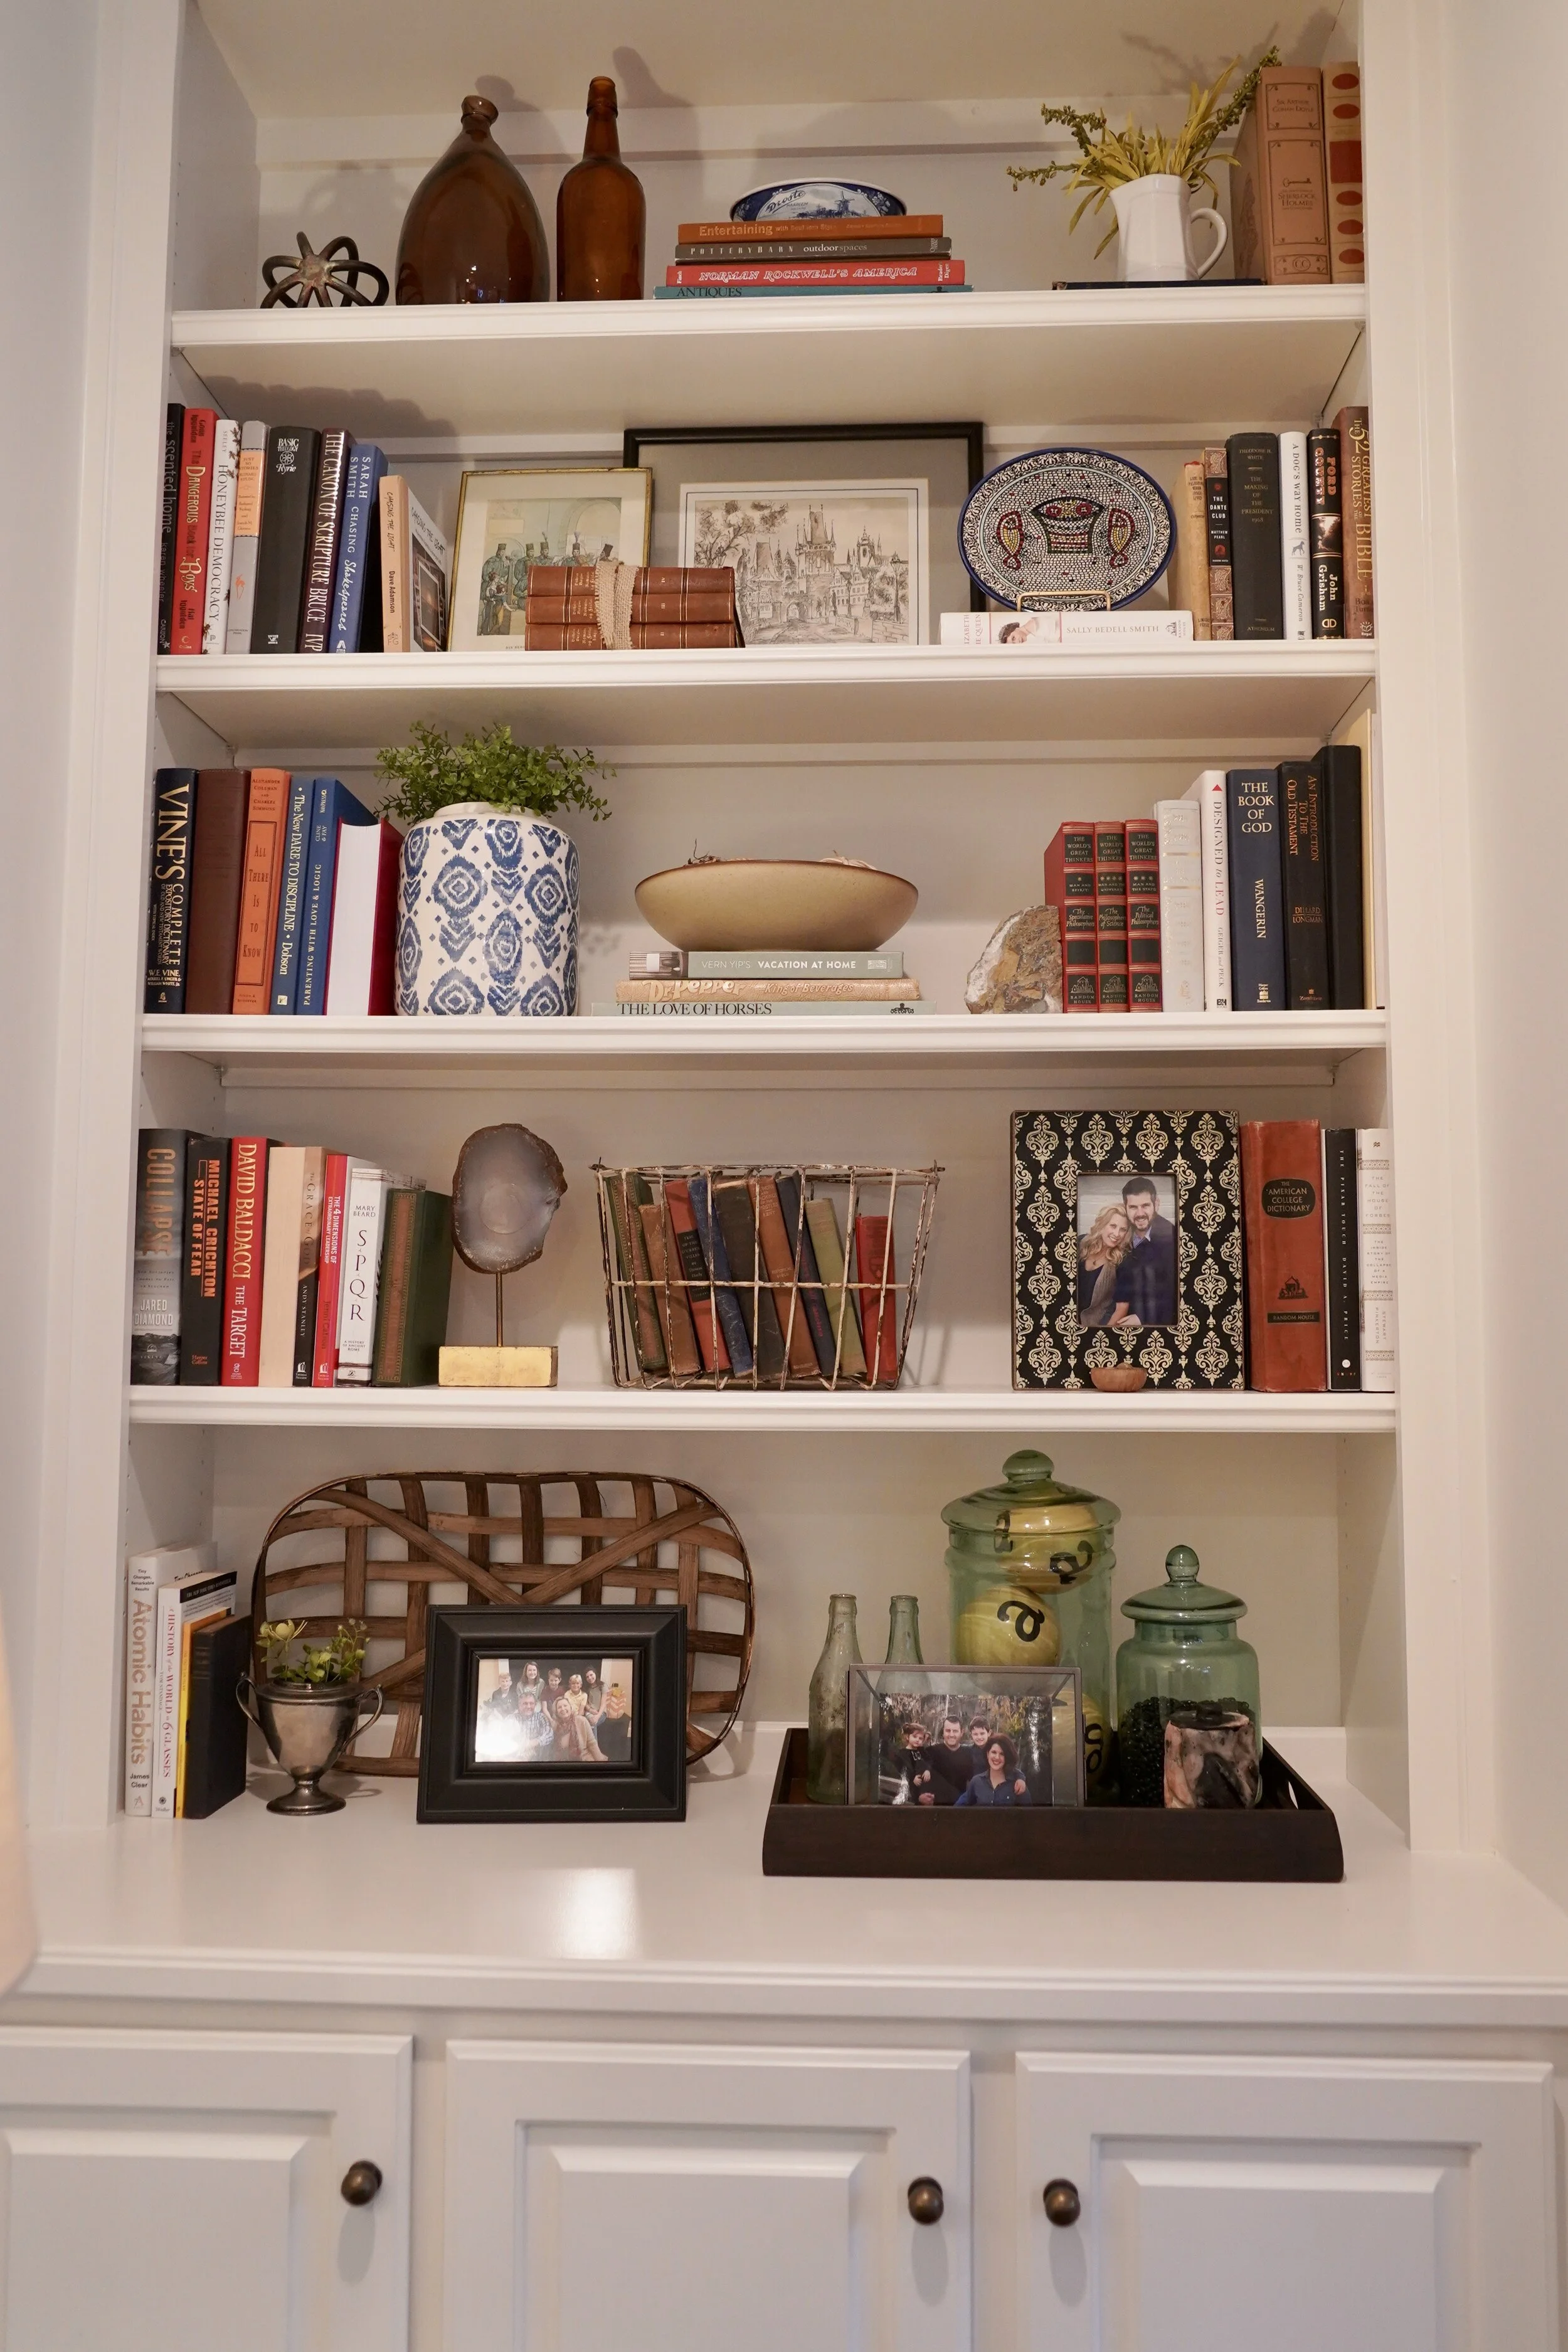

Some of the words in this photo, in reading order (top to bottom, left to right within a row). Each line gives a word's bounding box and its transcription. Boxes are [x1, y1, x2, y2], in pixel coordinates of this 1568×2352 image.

[765, 190, 805, 214] Droste
[699, 225, 773, 236] Entertaining
[677, 287, 743, 298] ANTIQUES
[699, 270, 760, 283] NORMAN
[763, 268, 849, 282] ROCKWELL'S
[852, 267, 918, 280] AMERICA
[278, 438, 300, 447] BASIC
[324, 431, 345, 456] THE
[164, 440, 177, 492] scented
[320, 457, 342, 500] CANON
[346, 456, 359, 499] SMITH
[358, 456, 371, 499] SARAH
[1315, 447, 1325, 506] COUNTY
[1327, 457, 1337, 495] FORD
[1351, 455, 1362, 508] STORIES
[214, 465, 228, 534] HONEYBEE
[1362, 455, 1372, 518] GREATEST
[162, 497, 177, 534] home
[318, 502, 337, 519] OF
[347, 506, 359, 553] CHASING
[310, 521, 336, 585] SCRIPTURE
[1356, 521, 1373, 581] BIBLE
[209, 538, 224, 621] DEMOCRACY
[1318, 564, 1328, 612] Grisham
[1330, 574, 1338, 601] John
[307, 587, 328, 623] BRUCE
[304, 633, 324, 652] IVP
[1237, 795, 1274, 806] BOOK
[1241, 782, 1268, 793] THE
[1287, 779, 1298, 800] OLD
[1308, 775, 1317, 790] AN
[292, 813, 304, 832] New
[294, 795, 305, 812] The
[1248, 808, 1264, 819] OF
[1299, 800, 1308, 813] TO
[155, 783, 190, 879] VINE'S
[1214, 802, 1223, 865] DESIGNED
[1241, 822, 1272, 833] GOD
[1288, 802, 1298, 856] TESTAMENT
[1300, 816, 1309, 835] THE
[1308, 793, 1319, 861] INTRODUCTION
[290, 833, 302, 860] DARE
[288, 861, 300, 876] TO
[313, 864, 322, 892] LOGIC
[163, 884, 174, 924] EXPOSITORY
[283, 877, 299, 932] DISCIPLINE
[310, 903, 319, 926] LOVE
[1214, 881, 1224, 916] LEAD
[1254, 879, 1266, 939] WANGERIN
[169, 883, 184, 965] COMPLETE
[308, 929, 317, 953] WITH
[162, 924, 171, 966] DICTIONARY
[280, 941, 293, 975] Dobson
[304, 955, 314, 1005] PARENTING
[757, 961, 808, 969] VACATION
[810, 961, 824, 969] AT
[826, 961, 856, 969] HOME
[764, 983, 789, 995] King
[790, 983, 802, 993] of
[802, 983, 854, 995] Beverages
[617, 1004, 650, 1015] THE
[652, 1004, 691, 1015] LOVE
[692, 1004, 712, 1015] OF
[714, 1003, 773, 1015] HORSES
[236, 1143, 257, 1194] DAVID
[142, 1148, 176, 1257] COLLAPSE
[193, 1179, 204, 1219] STATE
[206, 1160, 220, 1222] MICHAEL
[305, 1183, 316, 1227] GRACE
[191, 1223, 203, 1240] OF
[232, 1197, 255, 1279] BALDACCI
[331, 1216, 339, 1255] DIMENSIONS
[191, 1243, 203, 1276] FEAR
[204, 1227, 218, 1297] CRICHTON
[331, 1256, 337, 1264] OF
[140, 1299, 167, 1311] JARED
[235, 1285, 245, 1305] THE
[135, 1314, 173, 1326] DIAMOND
[229, 1307, 248, 1359] TARGET
[132, 1598, 154, 1684] Atomic
[166, 1614, 176, 1657] HISTORY
[165, 1674, 174, 1714] WORLD
[130, 1690, 152, 1766] Habits
[163, 1732, 172, 1778] GLASSES
